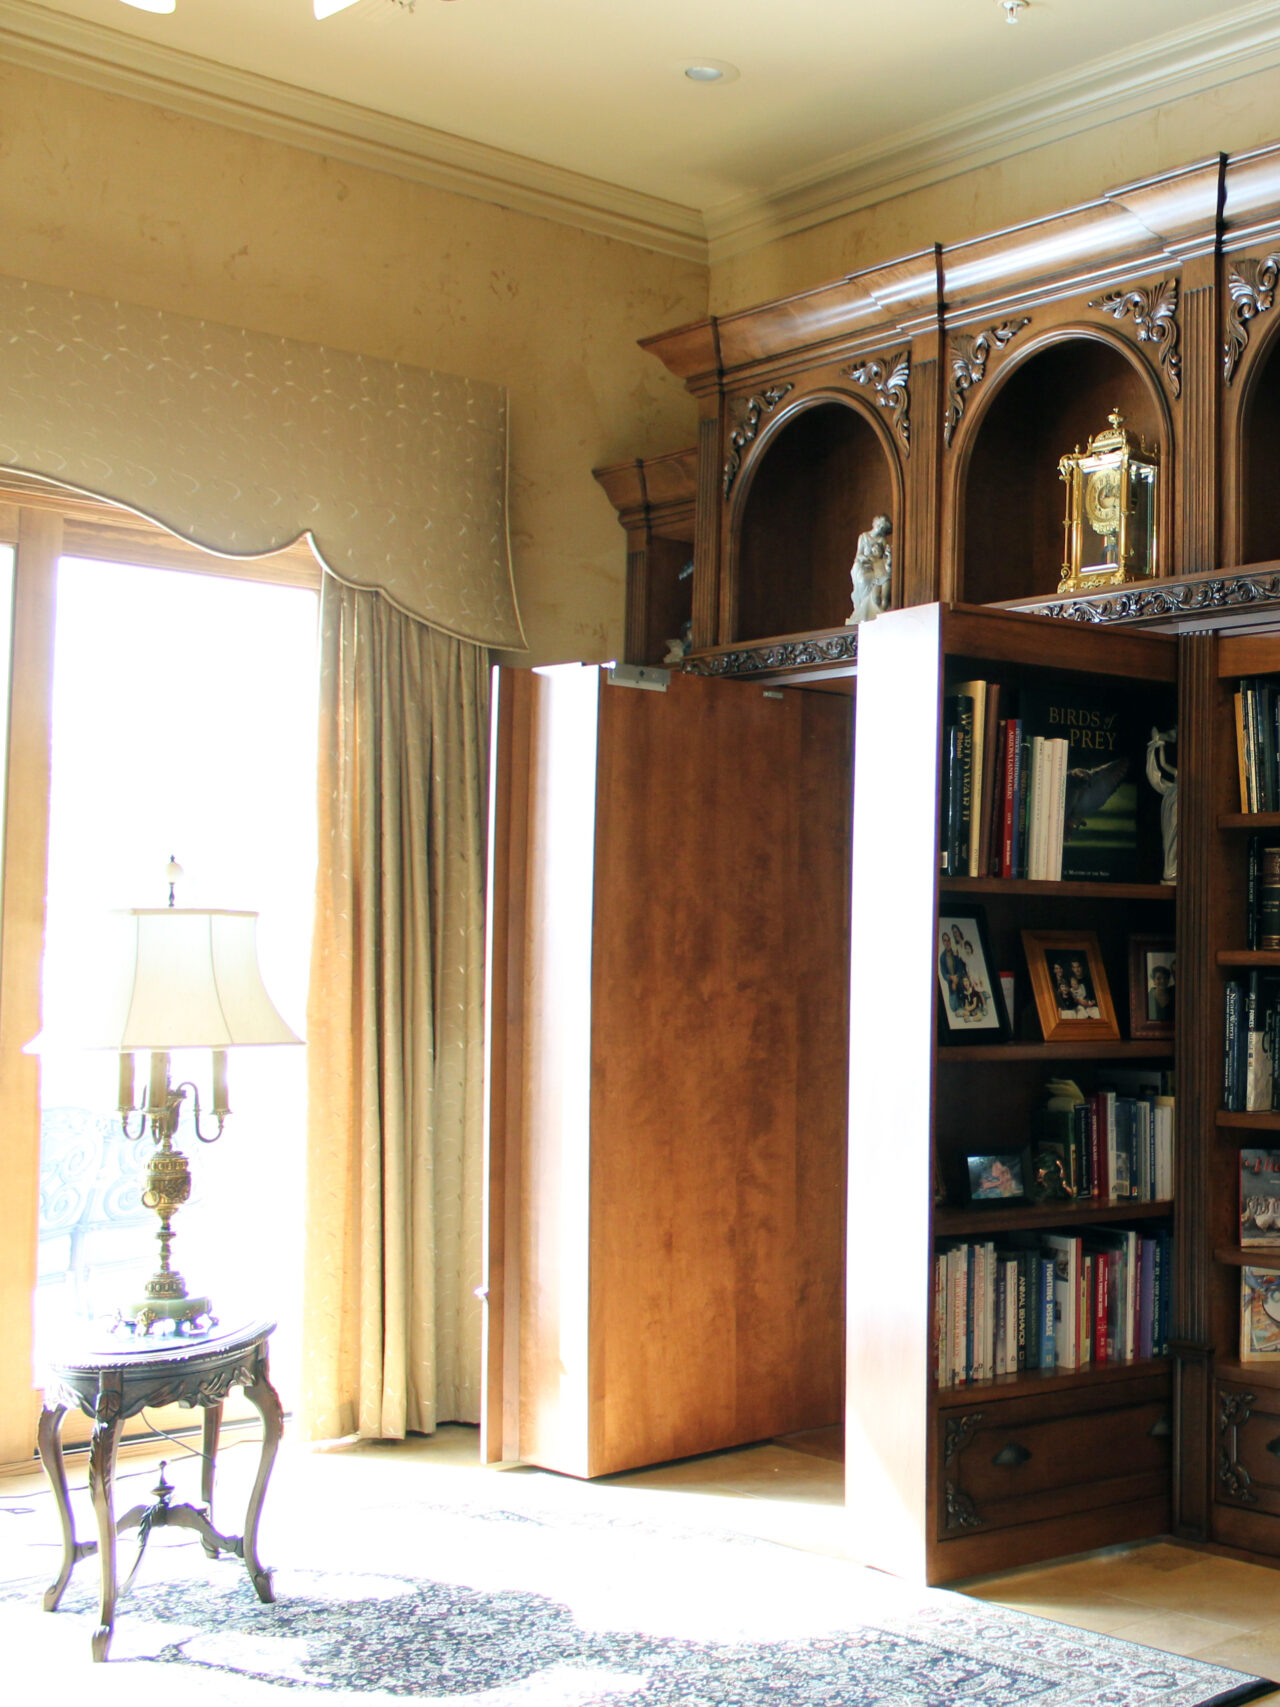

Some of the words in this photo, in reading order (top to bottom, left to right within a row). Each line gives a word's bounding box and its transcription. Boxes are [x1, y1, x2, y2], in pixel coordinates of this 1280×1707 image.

[1050, 707, 1099, 727] BIRDS
[1104, 713, 1117, 729] of
[1070, 729, 1117, 750] PREY
